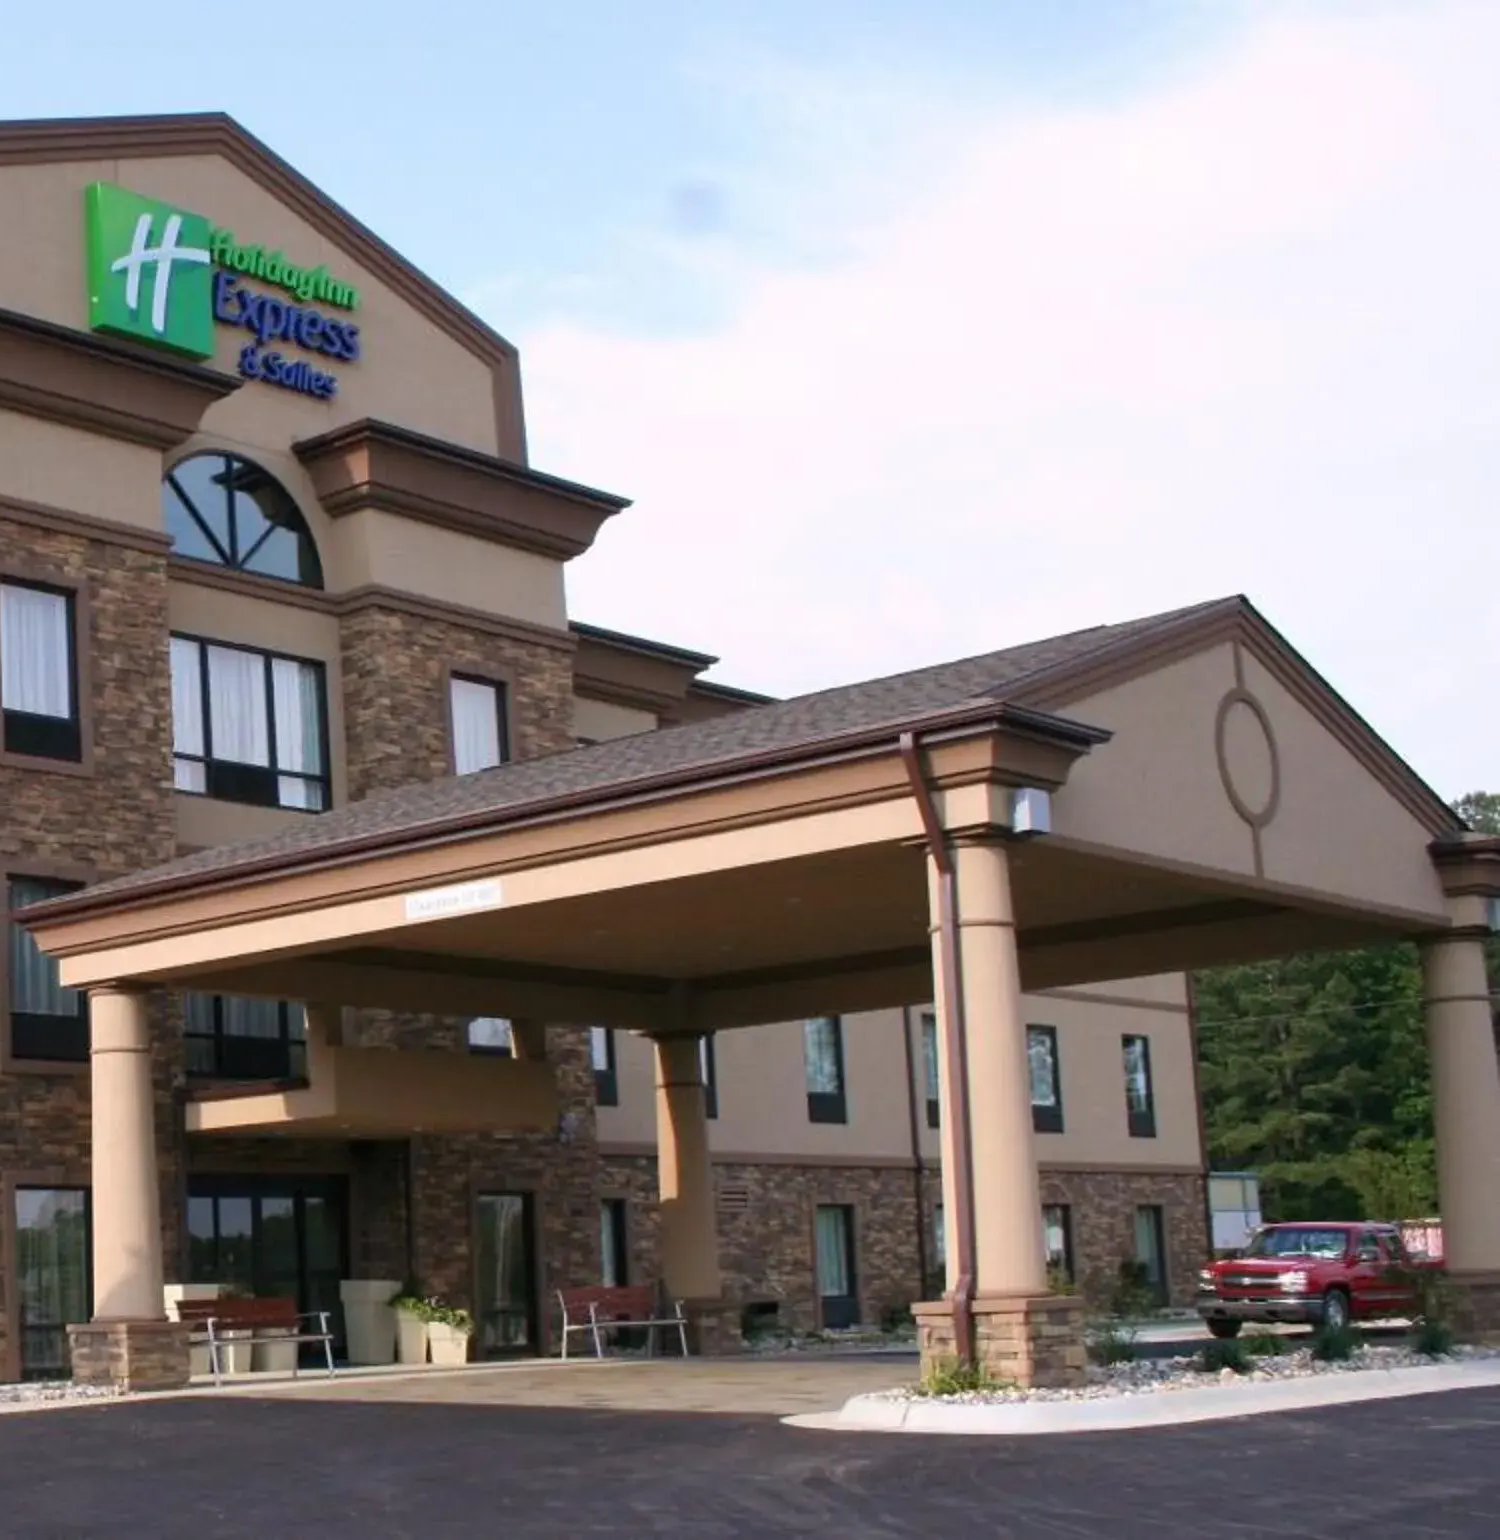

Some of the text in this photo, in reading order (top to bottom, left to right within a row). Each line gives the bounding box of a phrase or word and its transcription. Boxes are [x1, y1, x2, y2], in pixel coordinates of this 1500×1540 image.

[210, 229, 359, 311] Holiday Inn
[212, 271, 361, 363] Express
[238, 342, 338, 400] & Suites
